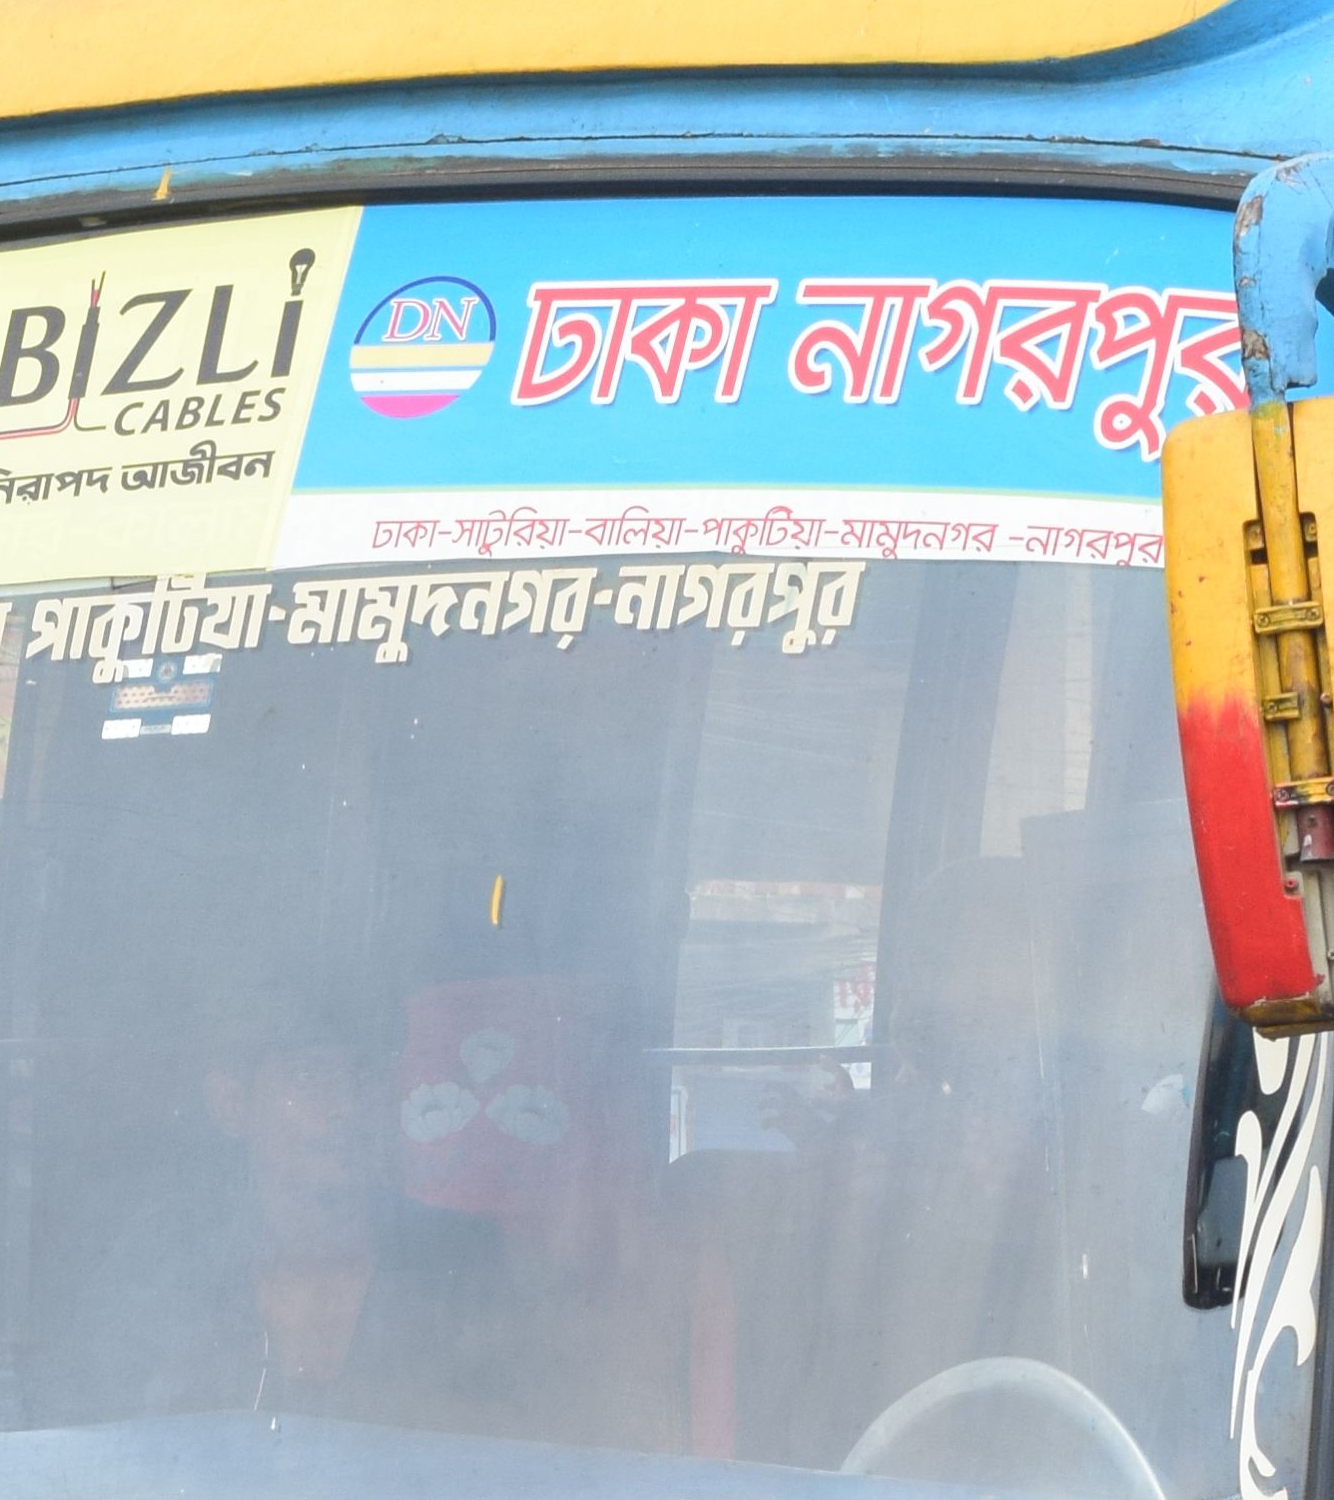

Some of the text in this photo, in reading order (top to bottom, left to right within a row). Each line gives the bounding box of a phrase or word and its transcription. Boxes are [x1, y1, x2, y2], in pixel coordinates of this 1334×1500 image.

[382, 297, 479, 343] DN
[511, 277, 779, 406] ঢাকা
[114, 387, 287, 436] CABLES
[121, 439, 276, 493] আজীবন
